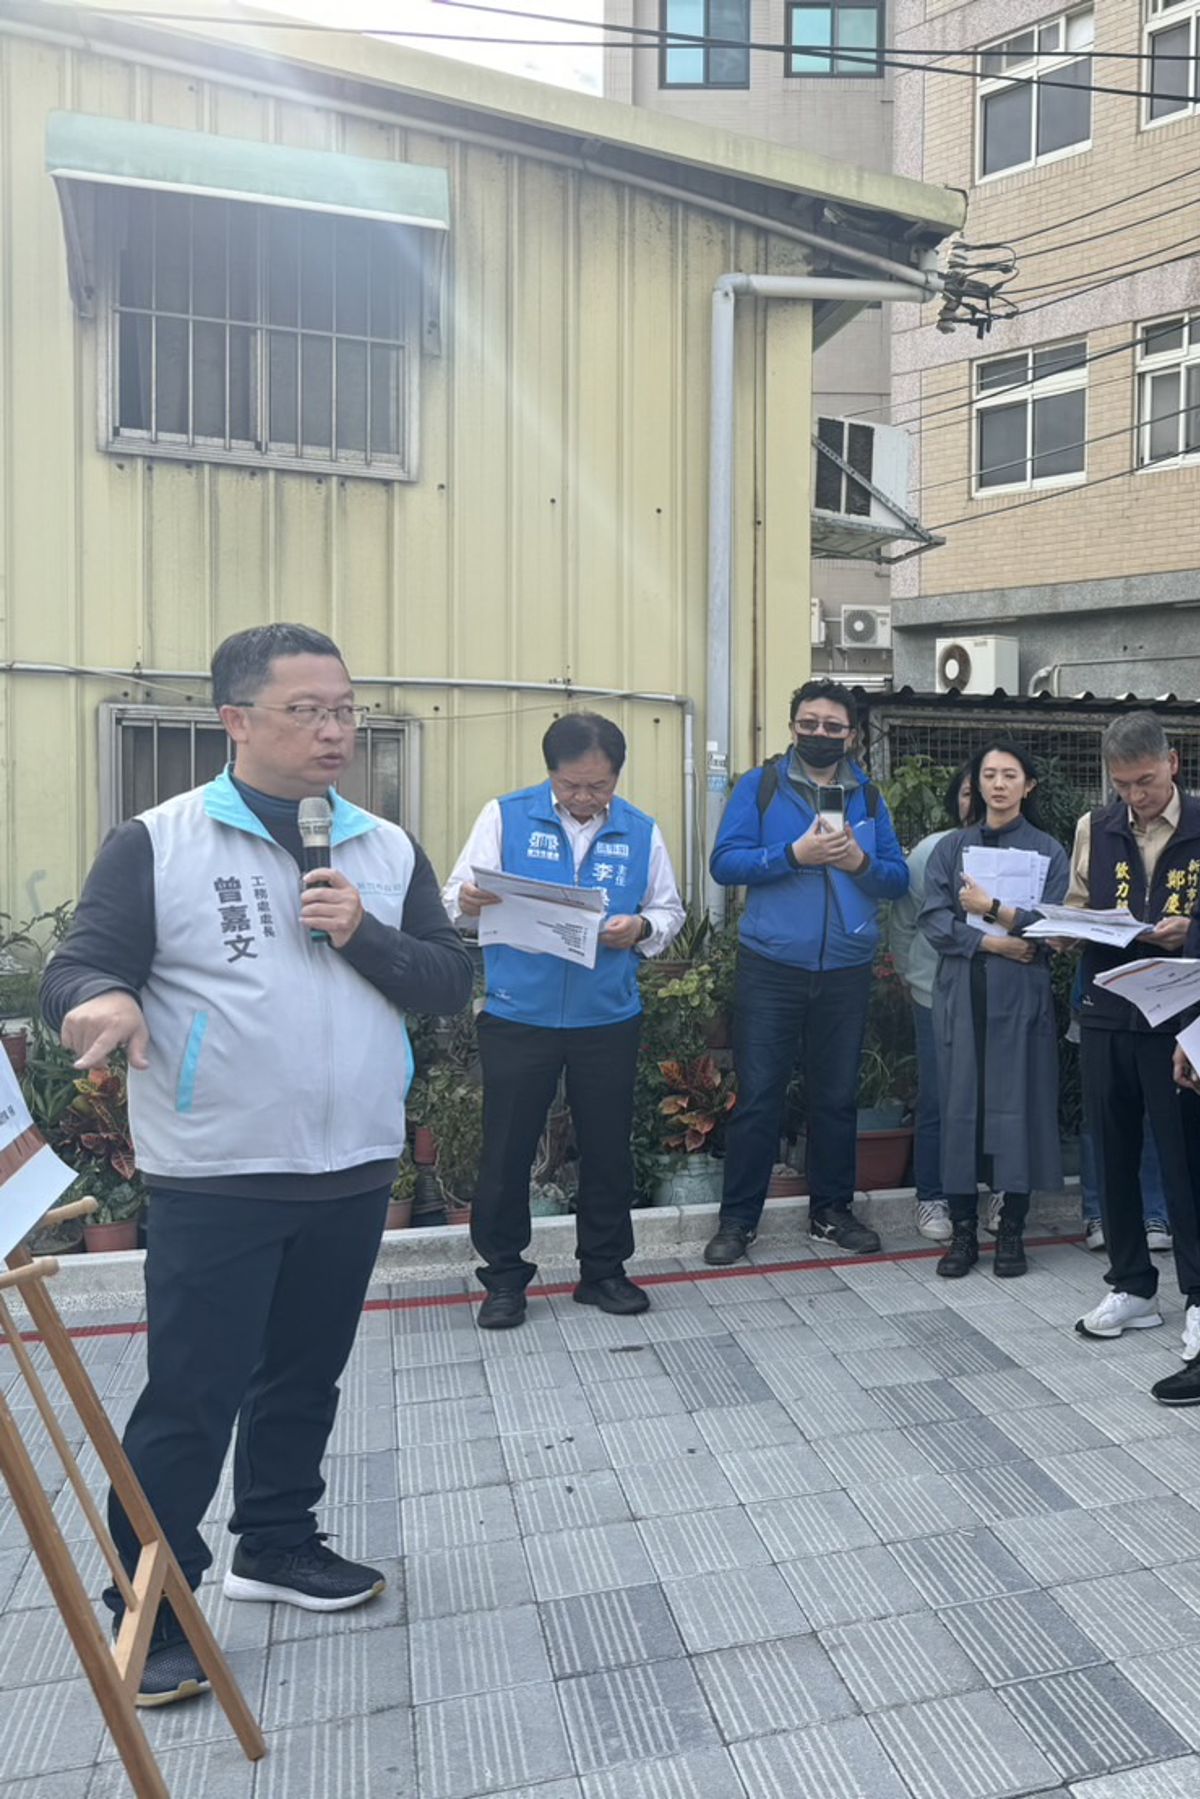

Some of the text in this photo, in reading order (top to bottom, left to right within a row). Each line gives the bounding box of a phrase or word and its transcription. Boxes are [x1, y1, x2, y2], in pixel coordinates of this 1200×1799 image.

[214, 876, 258, 963] 曾嘉文
[250, 875, 276, 938] 工務處處長
